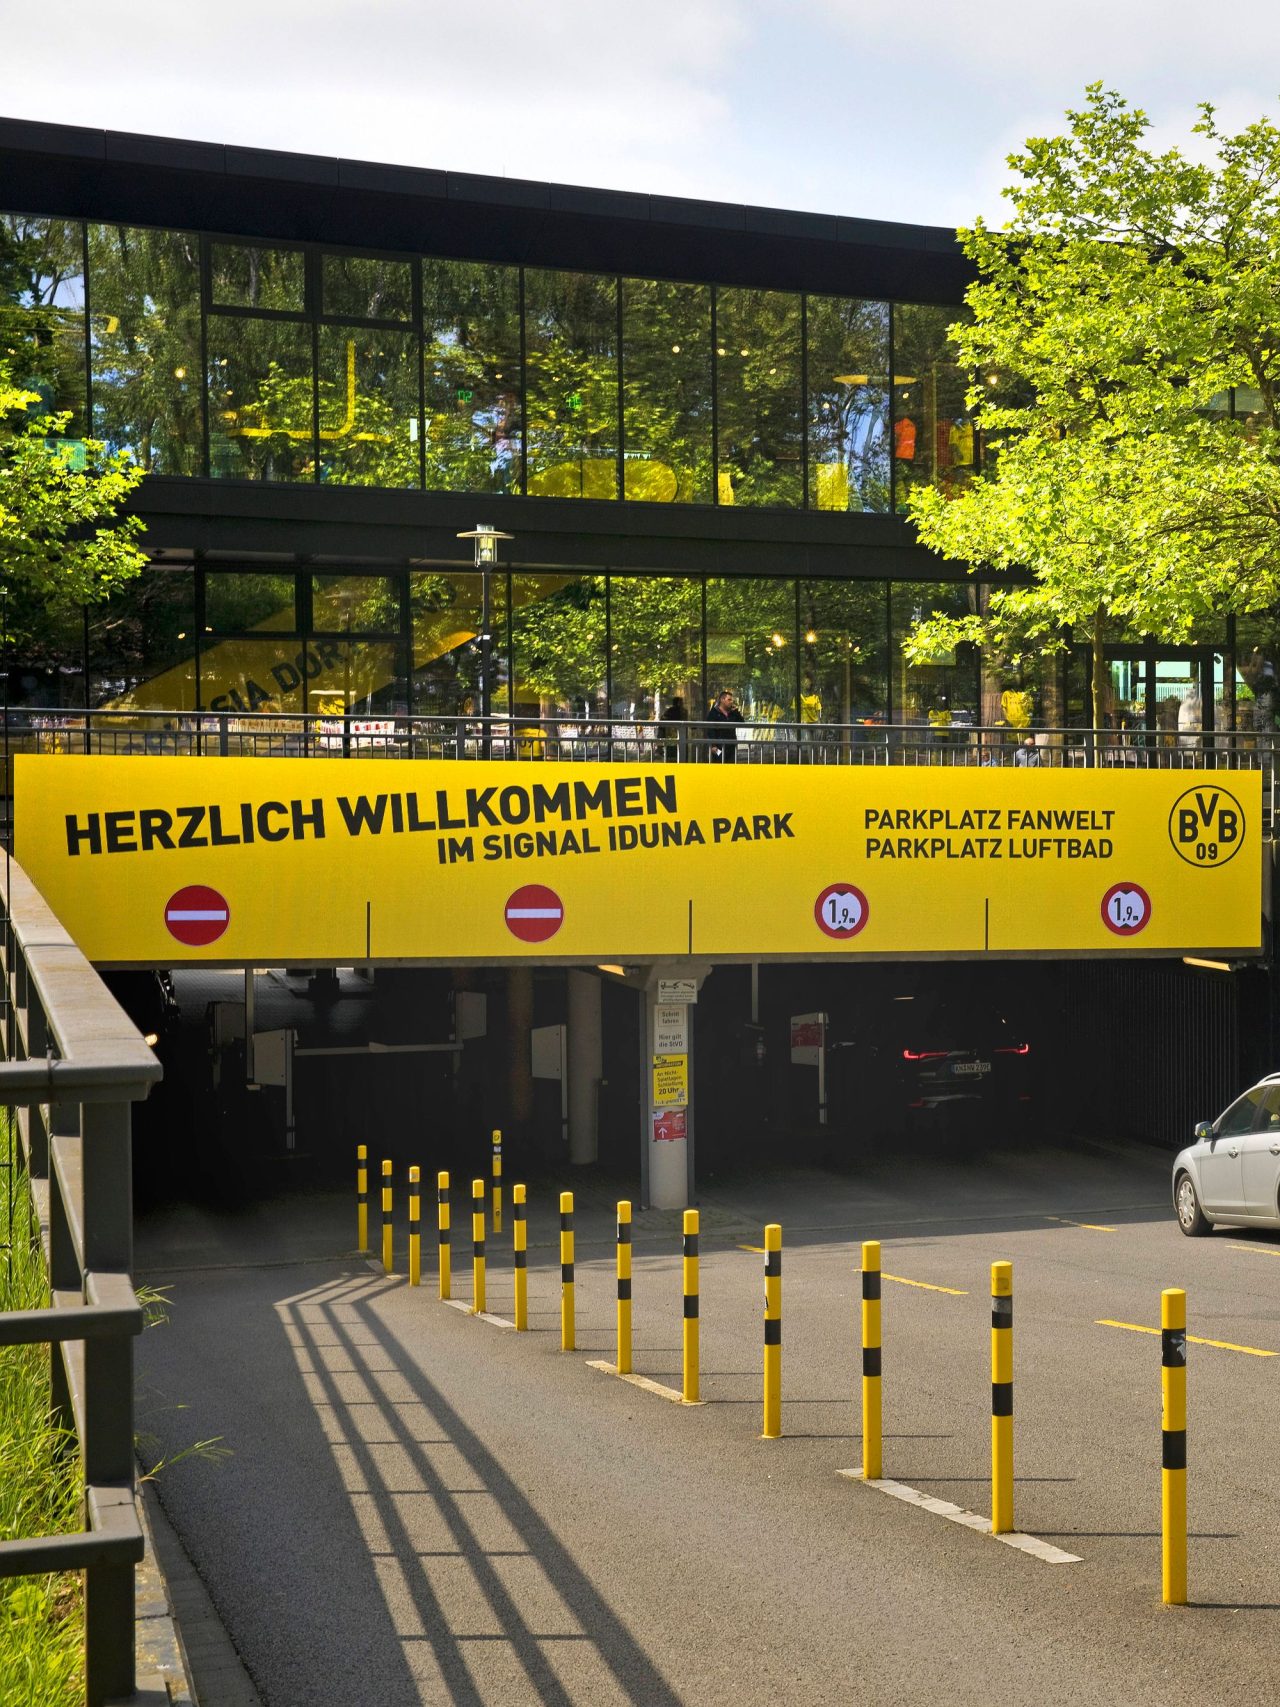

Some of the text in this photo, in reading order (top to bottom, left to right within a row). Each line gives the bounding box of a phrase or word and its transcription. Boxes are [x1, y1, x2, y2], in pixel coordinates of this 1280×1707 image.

[65, 775, 677, 857] HERZLICH WILLKOMMEN
[865, 809, 1116, 830] PARKPLATZ FANWELT
[1178, 792, 1238, 843] BVB
[438, 812, 795, 865] IM SIGNAL IDUNA PARK
[866, 838, 1113, 859] PARKPLATZ LUFTBAD
[1196, 842, 1218, 861] 09
[667, 1087, 680, 1095] Uhr
